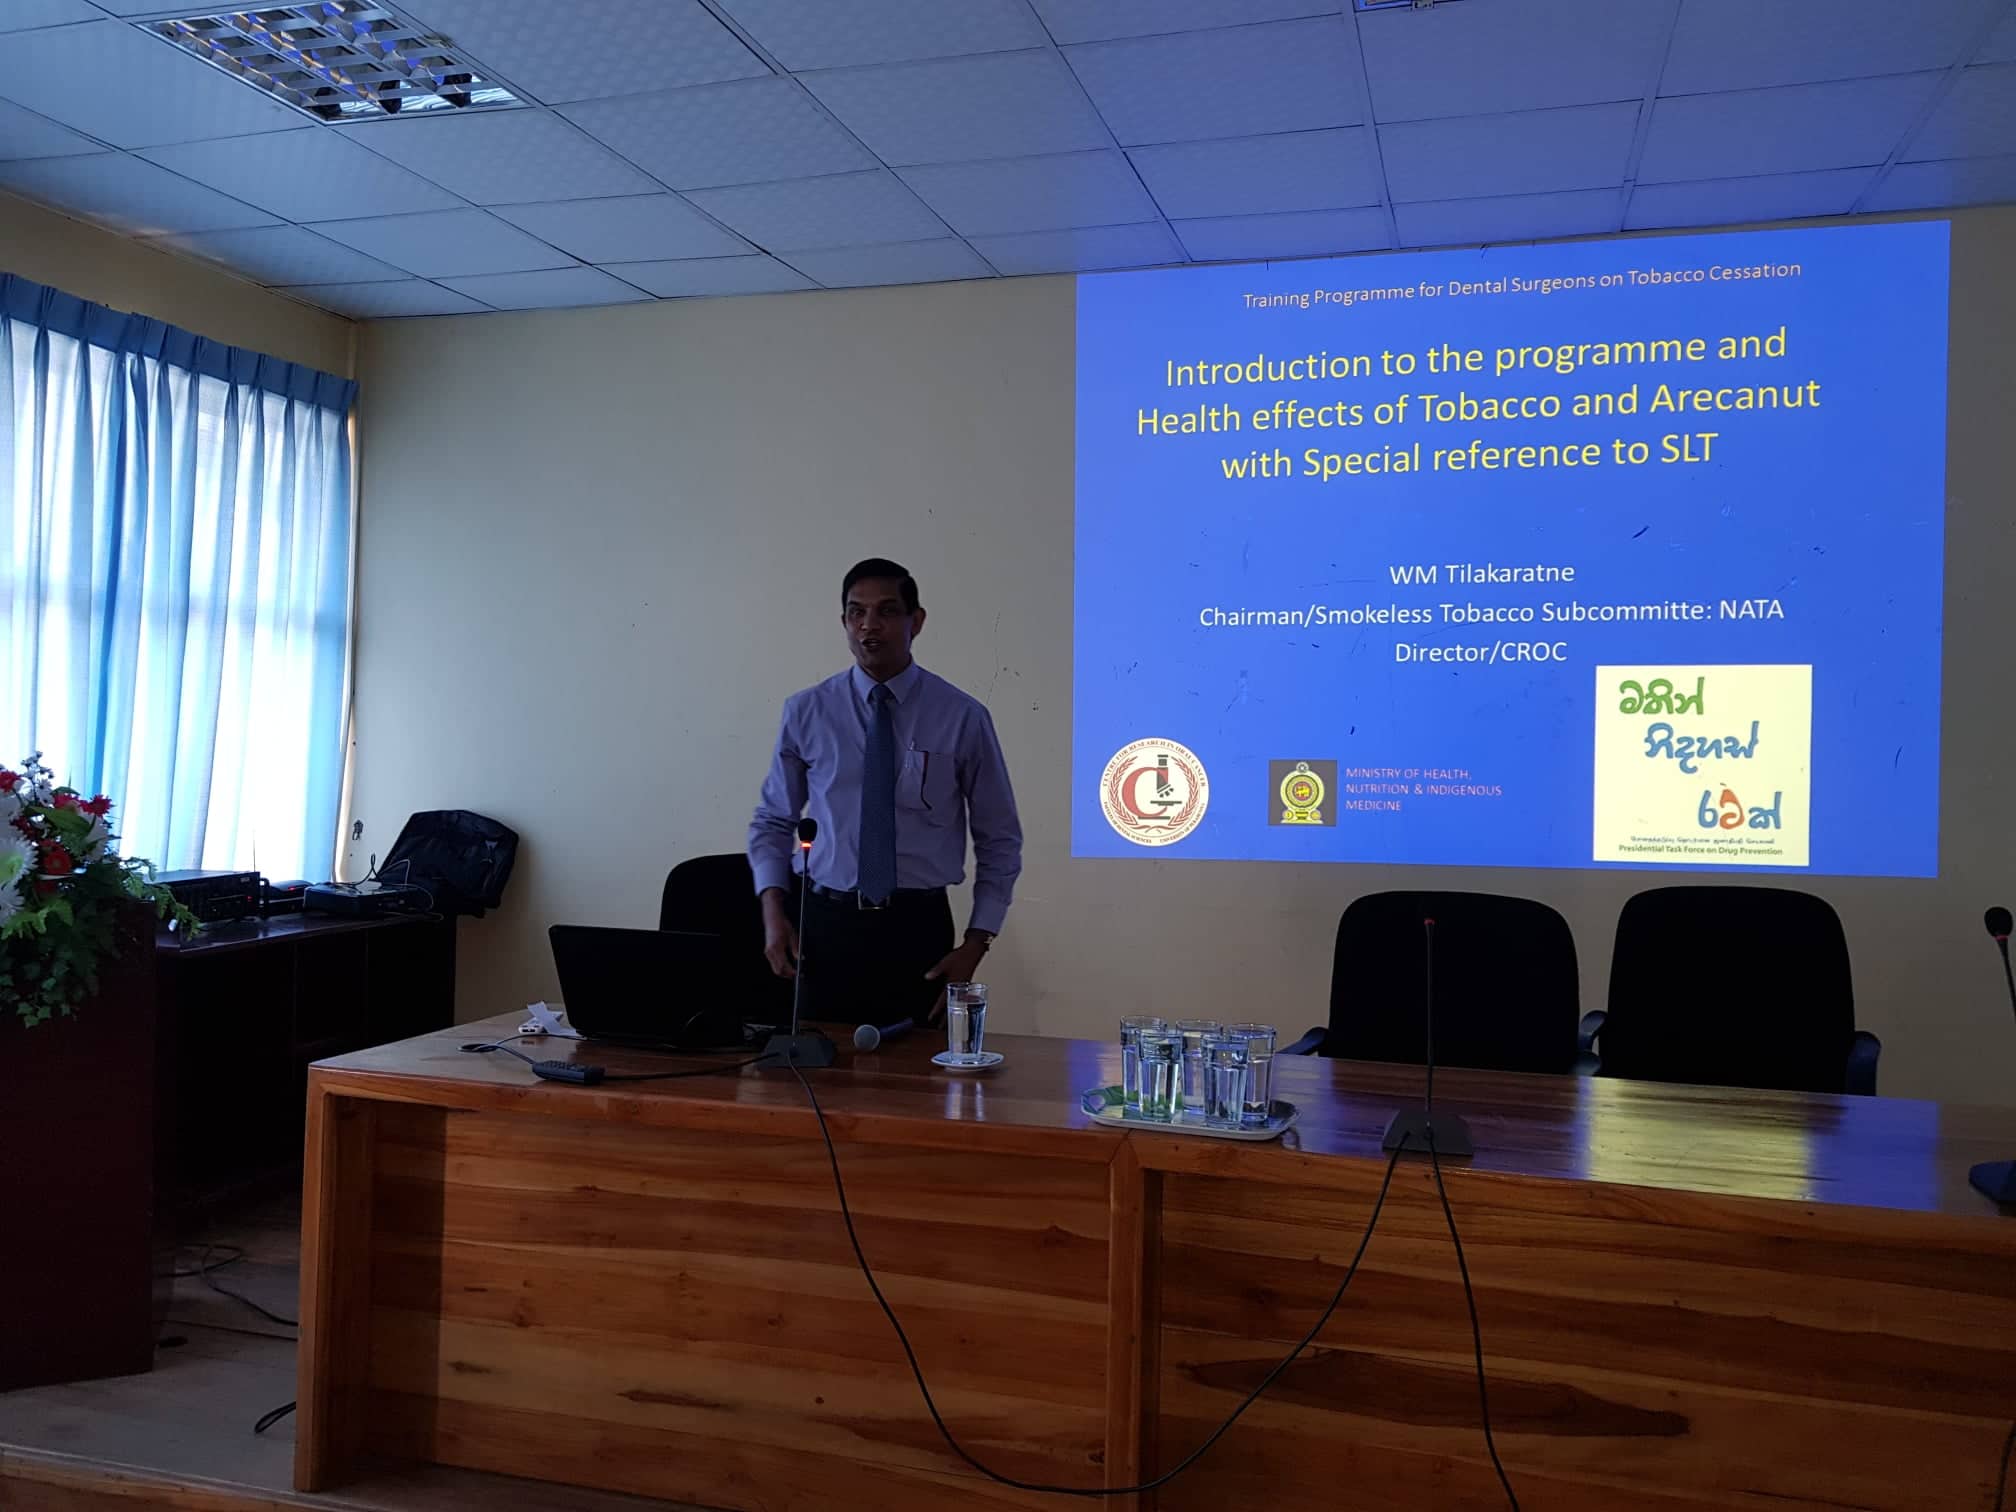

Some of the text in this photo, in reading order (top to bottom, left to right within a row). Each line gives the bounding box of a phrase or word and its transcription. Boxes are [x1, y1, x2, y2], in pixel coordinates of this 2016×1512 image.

[1243, 262, 1802, 309] Training Programme for Dental Surgeons on Tobacco Cessation
[1167, 325, 1787, 387] Introduction to the programme and
[1137, 379, 1822, 436] Health effects of Tobacco and Arecanut
[1221, 432, 1720, 483] with Special reference to SLT
[1388, 562, 1575, 585] WM Tilakaratne
[1199, 598, 1785, 628] Chairman/Smokeless Tobacco Subcommitte: NATA
[1395, 639, 1568, 665] Director/CROC
[1345, 768, 1401, 778] MINISTRY
[1404, 768, 1419, 779] OF
[1345, 783, 1502, 796] NUTRITION & INDIGENOUS
[1345, 800, 1401, 811] MEDICINE
[1619, 844, 1664, 853] Presidential
[1684, 846, 1705, 854] Force
[1718, 847, 1738, 856] Drug
